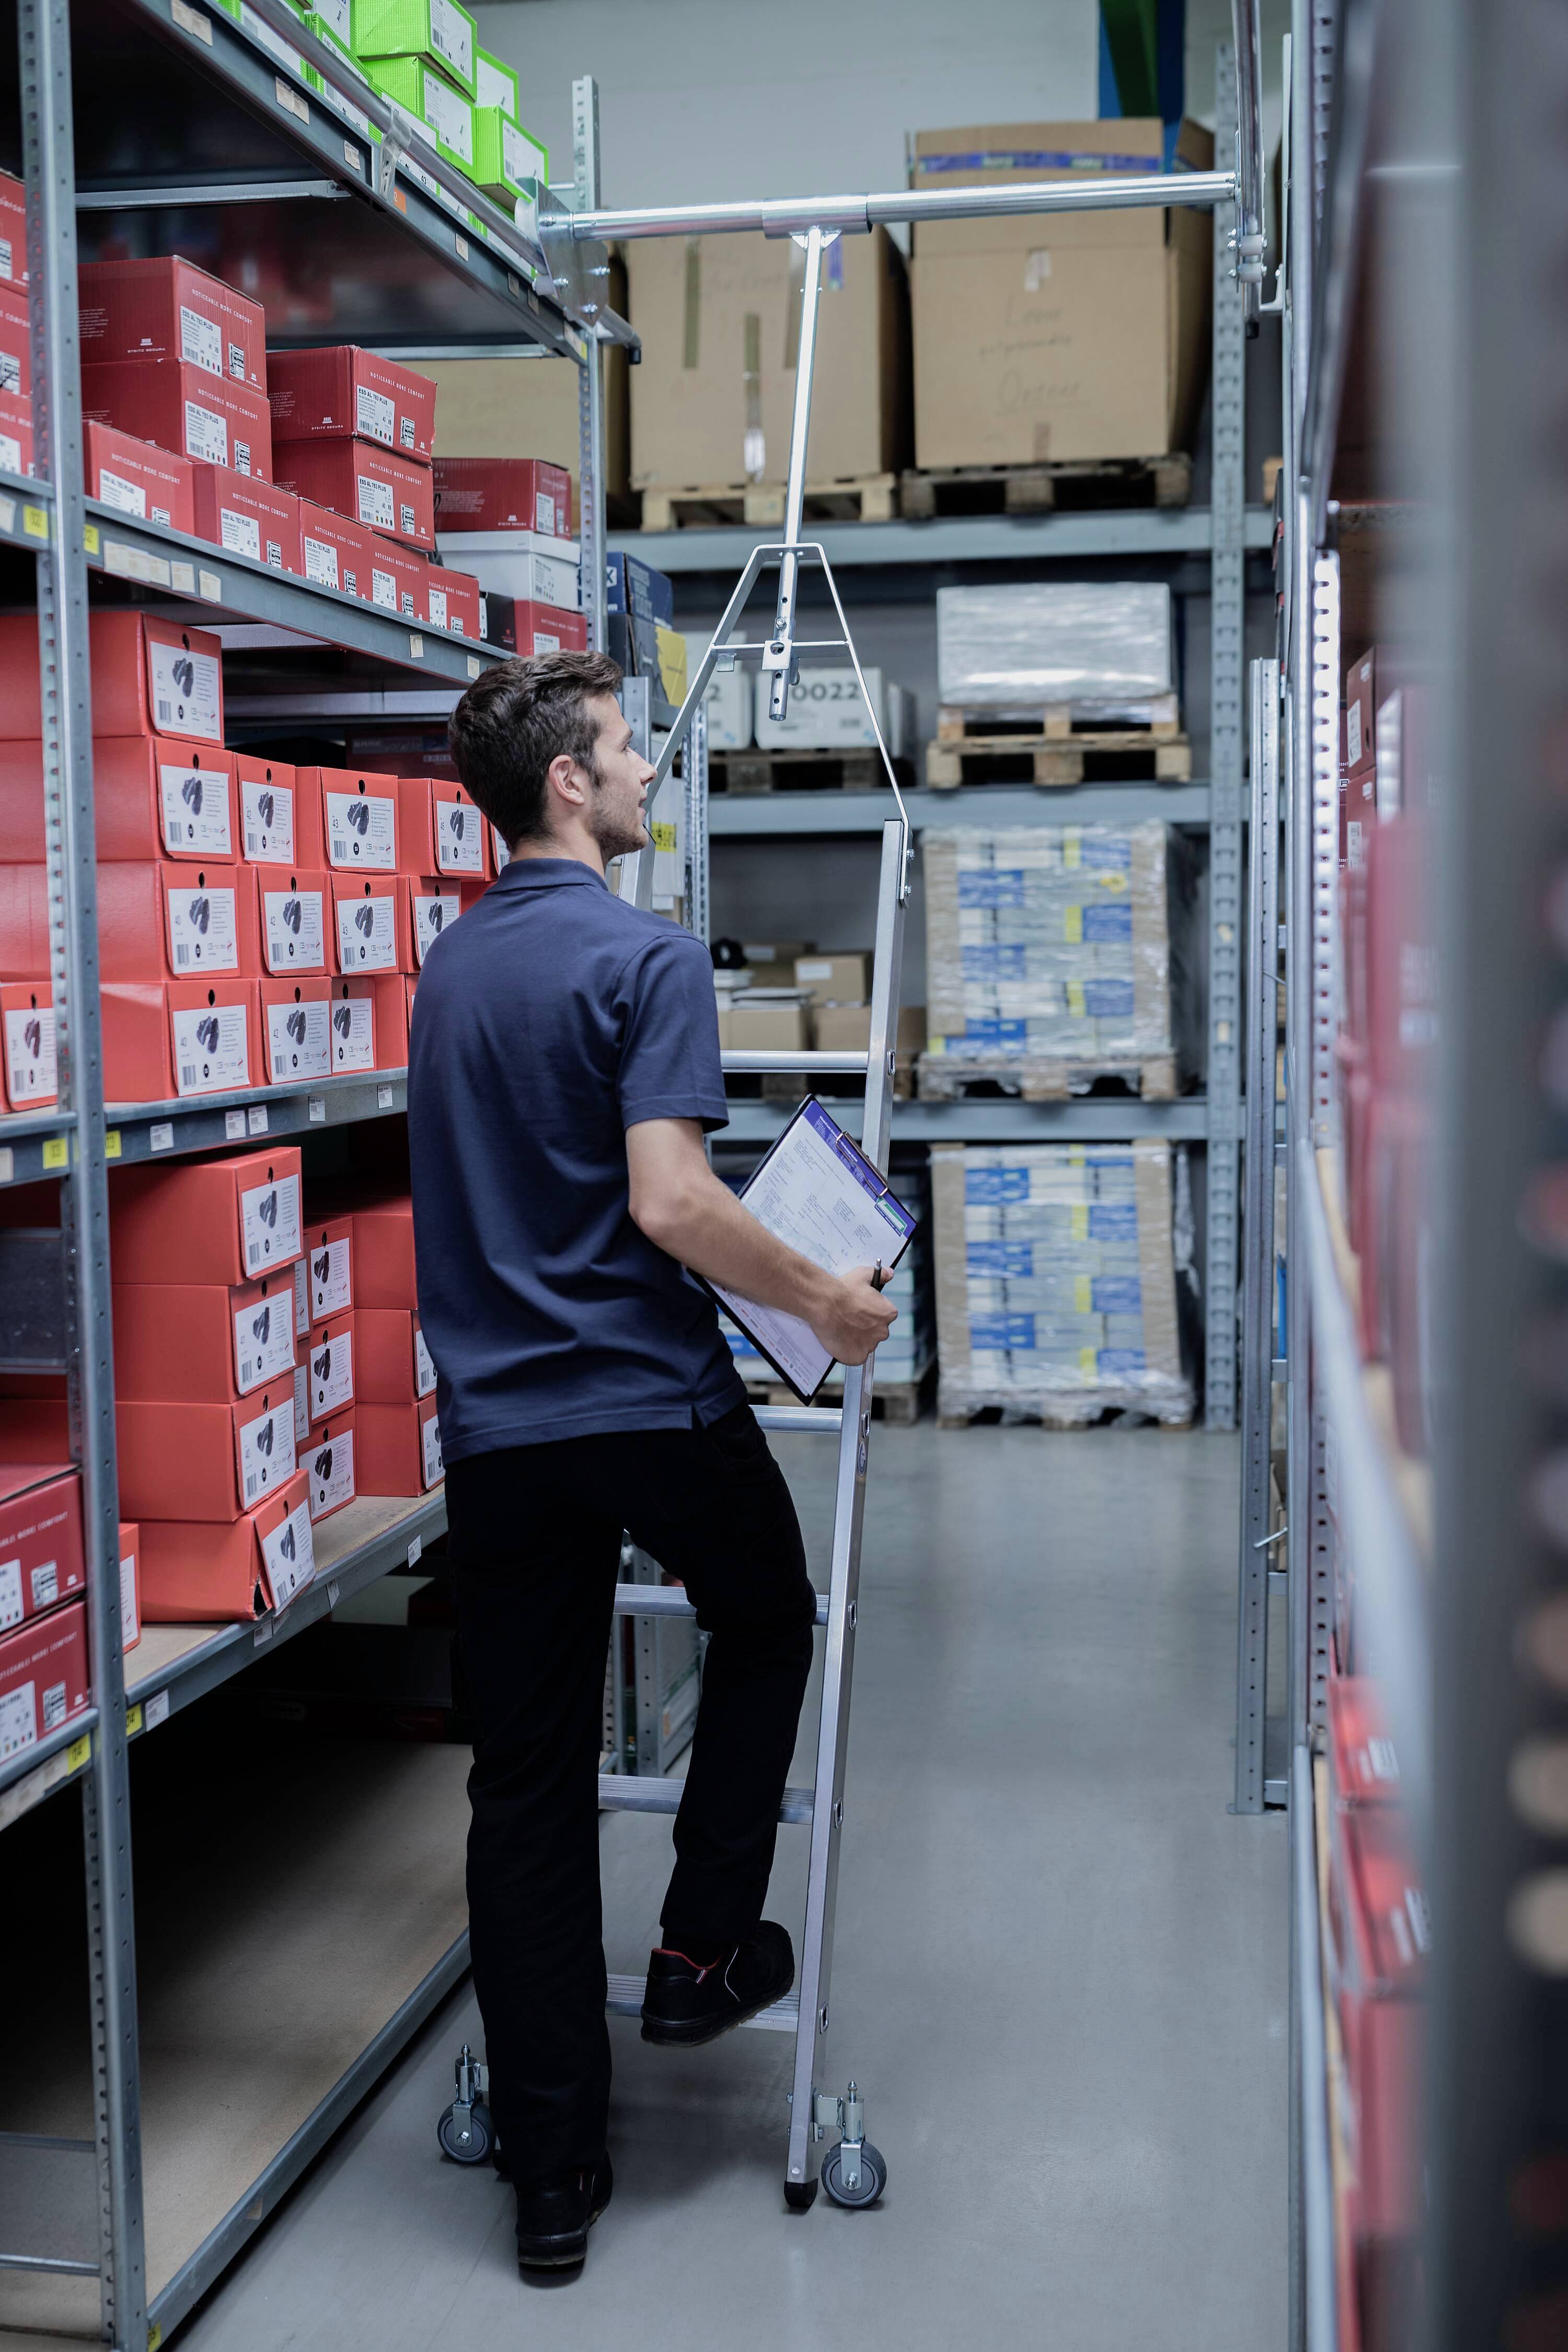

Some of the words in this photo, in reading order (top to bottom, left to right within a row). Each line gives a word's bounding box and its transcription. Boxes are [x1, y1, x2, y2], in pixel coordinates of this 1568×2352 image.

[421, 175, 426, 185] 43
[192, 289, 218, 307] NOTICEABLE
[220, 304, 232, 314] MORE
[234, 310, 252, 325] COMFORT
[370, 372, 395, 386] NOTICEABLE
[396, 383, 406, 391] MORE
[408, 388, 425, 400] COMFORT
[198, 388, 225, 405] NOTICEABLE
[226, 401, 238, 411] MORE
[239, 407, 258, 420] COMFORT
[370, 462, 393, 475] NOTICEABLE
[394, 471, 404, 479] MORE
[405, 475, 422, 486] COMFORT
[232, 493, 258, 507] NOTICEABLE
[259, 503, 270, 512] MORE
[271, 508, 289, 519] COMFORT
[315, 526, 336, 539] NOTICEABLE
[337, 535, 346, 543] MORE
[347, 539, 362, 549] COMFORT
[375, 551, 395, 563] NOTICEABLE
[395, 559, 405, 567] MORE
[405, 563, 420, 572] COMFORT
[429, 581, 445, 591] TICEABLE
[455, 590, 470, 598] COMFORT
[332, 819, 339, 828] 43
[343, 926, 348, 935] 43
